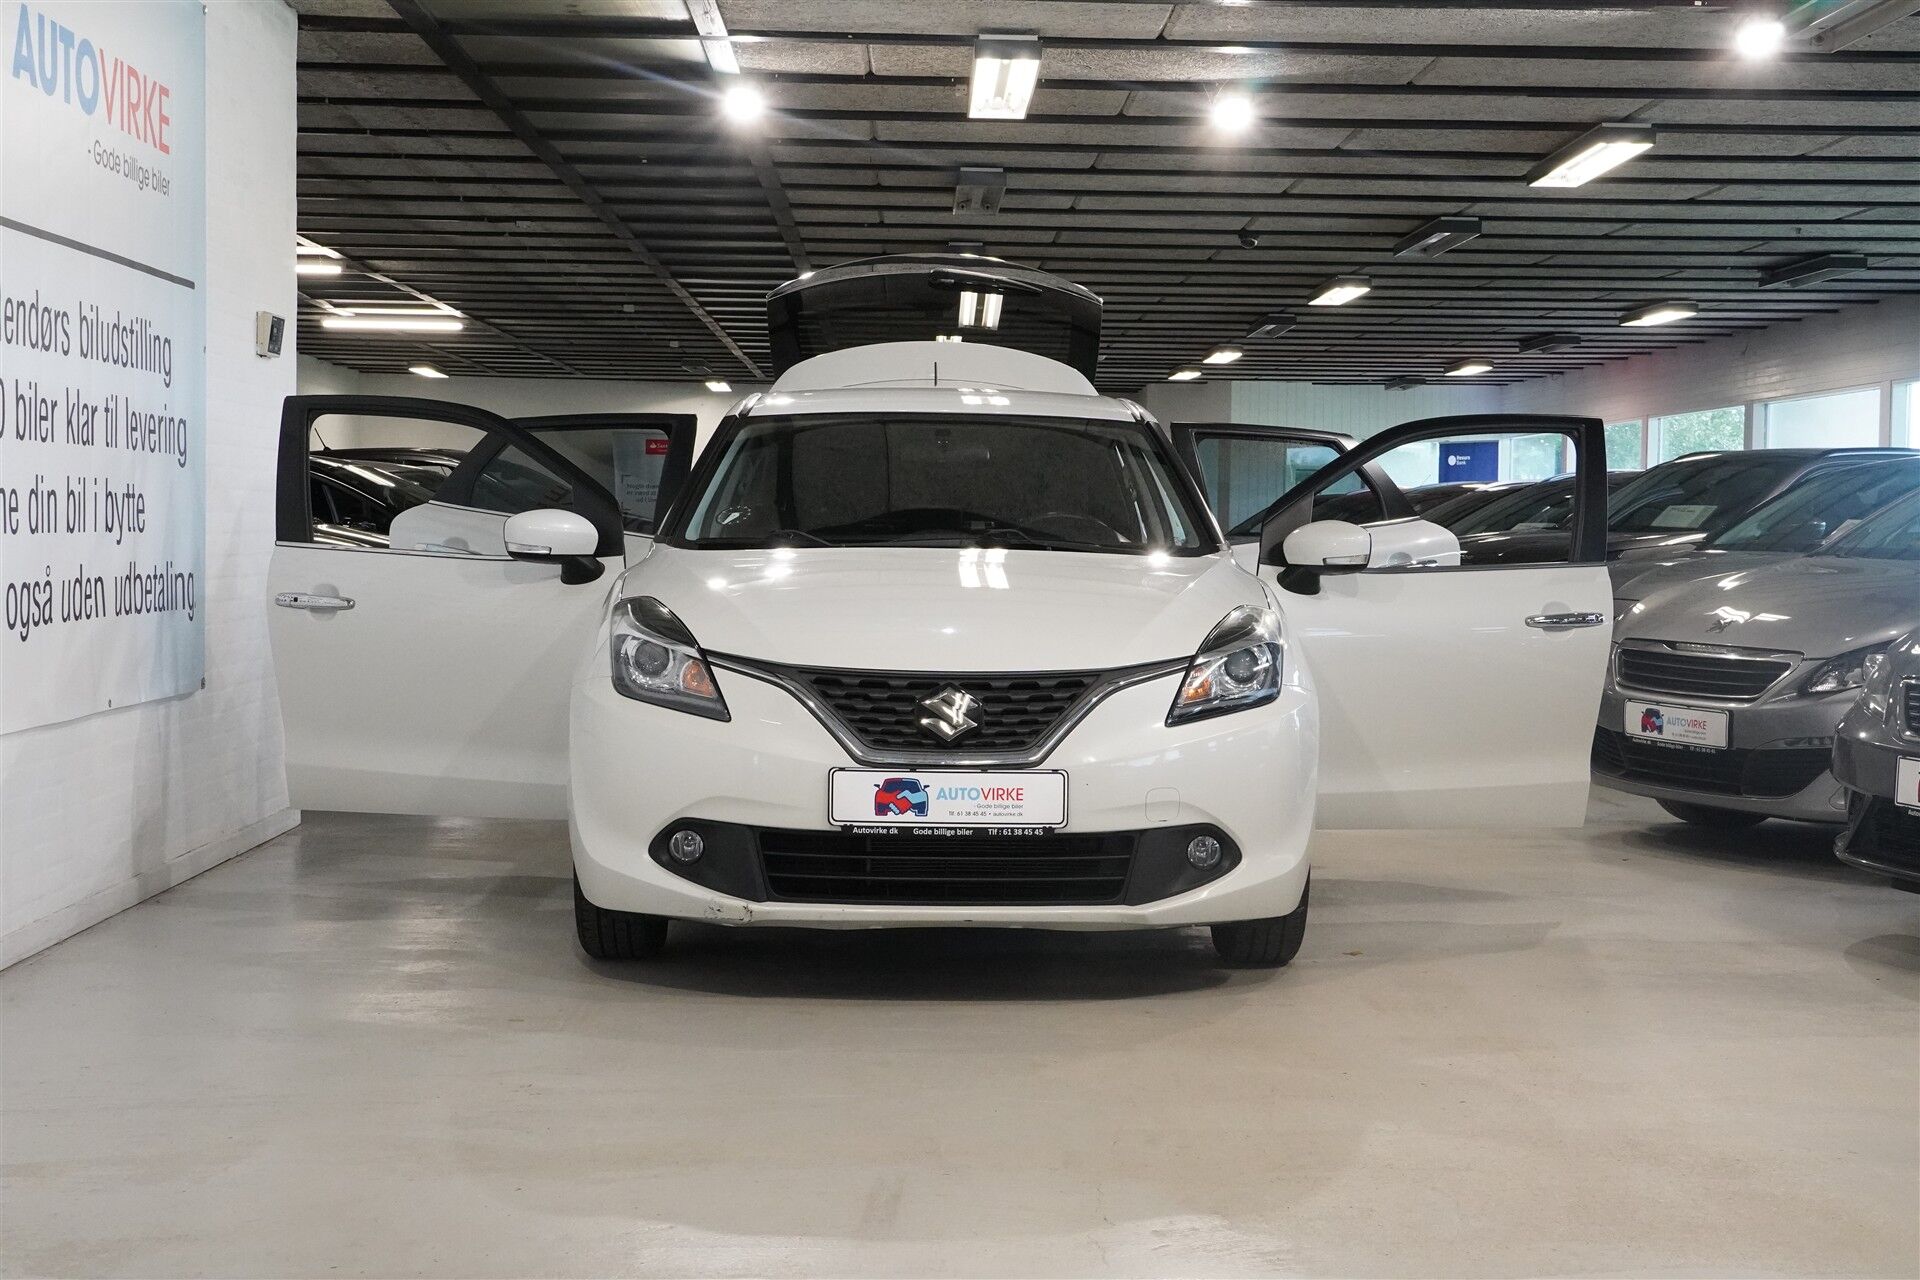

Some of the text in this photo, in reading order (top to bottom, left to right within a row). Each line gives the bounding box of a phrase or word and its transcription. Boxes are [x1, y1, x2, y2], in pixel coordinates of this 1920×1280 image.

[12, 4, 170, 155] AUTOVIRKE
[94, 139, 121, 174] Gode
[123, 153, 150, 191] billige
[152, 166, 170, 197] biler
[0, 290, 172, 388] endørs biludstilling
[15, 379, 58, 443] biler
[66, 387, 98, 446] klar
[104, 394, 118, 448] til
[125, 397, 188, 468] levering
[28, 474, 57, 535] din
[66, 475, 86, 534] bil
[105, 477, 146, 545] bytte
[6, 565, 53, 642] også
[61, 563, 106, 623] uden
[1666, 715, 1707, 730] AUTOVIRKE
[936, 787, 1024, 801] AUTOVIRKE
[852, 826, 888, 835] Autovirke
[913, 827, 973, 837] Gode billige biler
[1003, 828, 1012, 836] 61
[1013, 828, 1023, 836] 38
[1024, 828, 1033, 836] 45
[1034, 828, 1044, 836] 45
